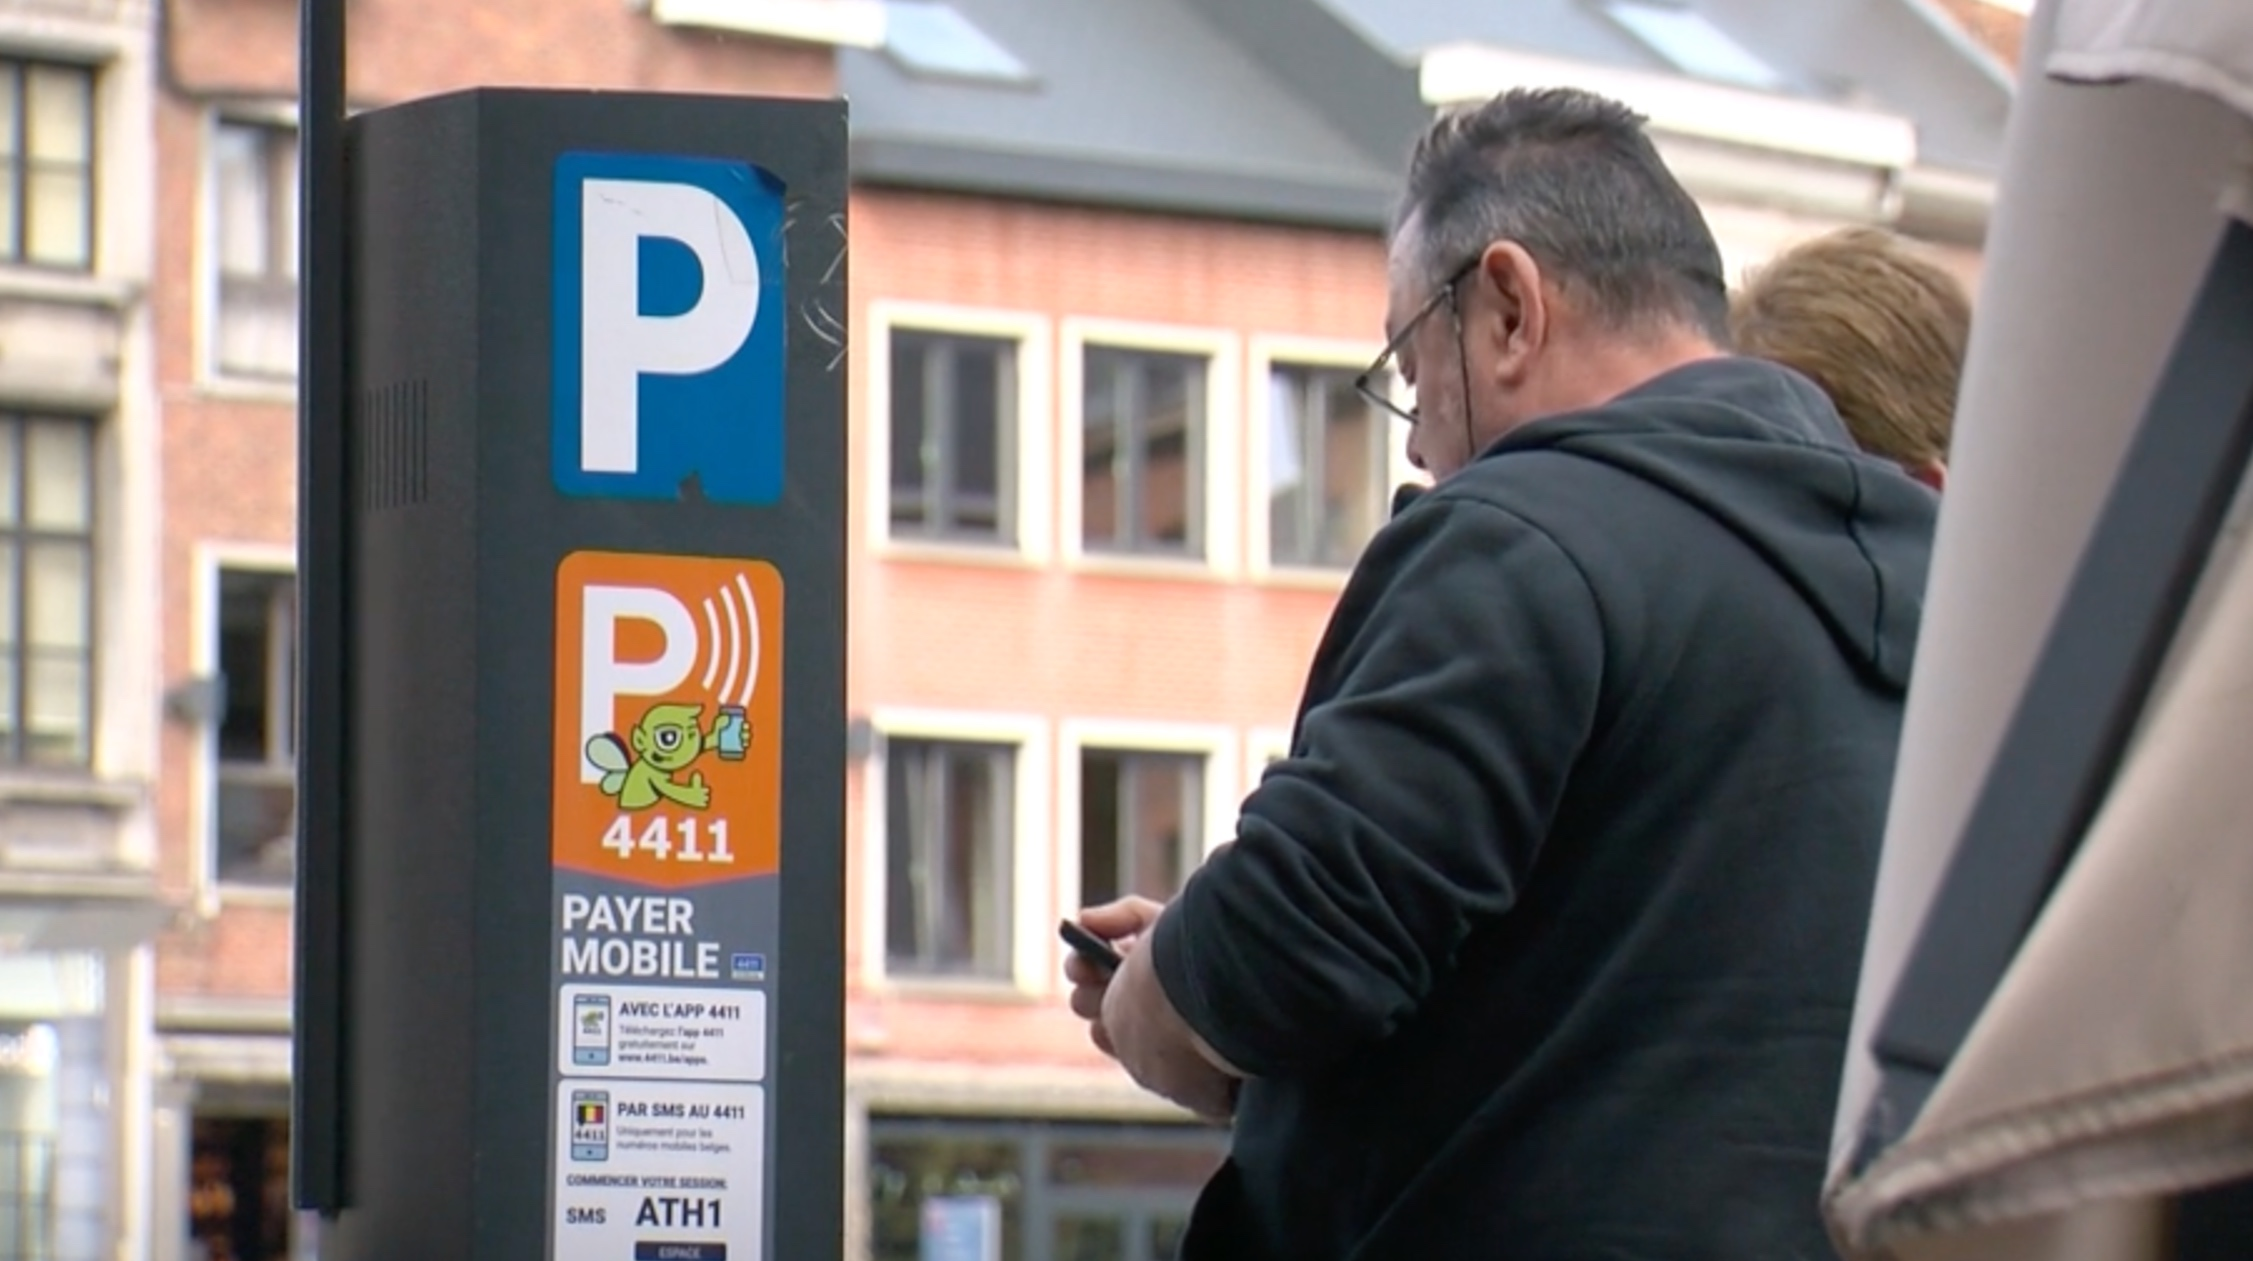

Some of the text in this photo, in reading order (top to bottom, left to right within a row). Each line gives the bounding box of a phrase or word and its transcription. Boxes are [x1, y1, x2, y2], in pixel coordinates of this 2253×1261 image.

[581, 178, 760, 474] P
[580, 585, 698, 783] P
[602, 814, 734, 863] 4411
[562, 894, 694, 935] PAYER
[562, 937, 720, 979] MOBILE
[619, 1002, 739, 1020] AVEC L'APP 4411
[703, 1027, 724, 1037] 4411
[618, 1040, 679, 1051] gratuitement
[617, 1102, 745, 1119] PAR SMS AU 4411
[574, 1129, 605, 1141] 4411
[616, 1126, 713, 1139] Uniquement pour les
[660, 1141, 697, 1152] mobiles
[566, 1174, 638, 1188] COMMENCER
[641, 1175, 677, 1188] VOTRE
[566, 1196, 721, 1227] SMS ATH1
